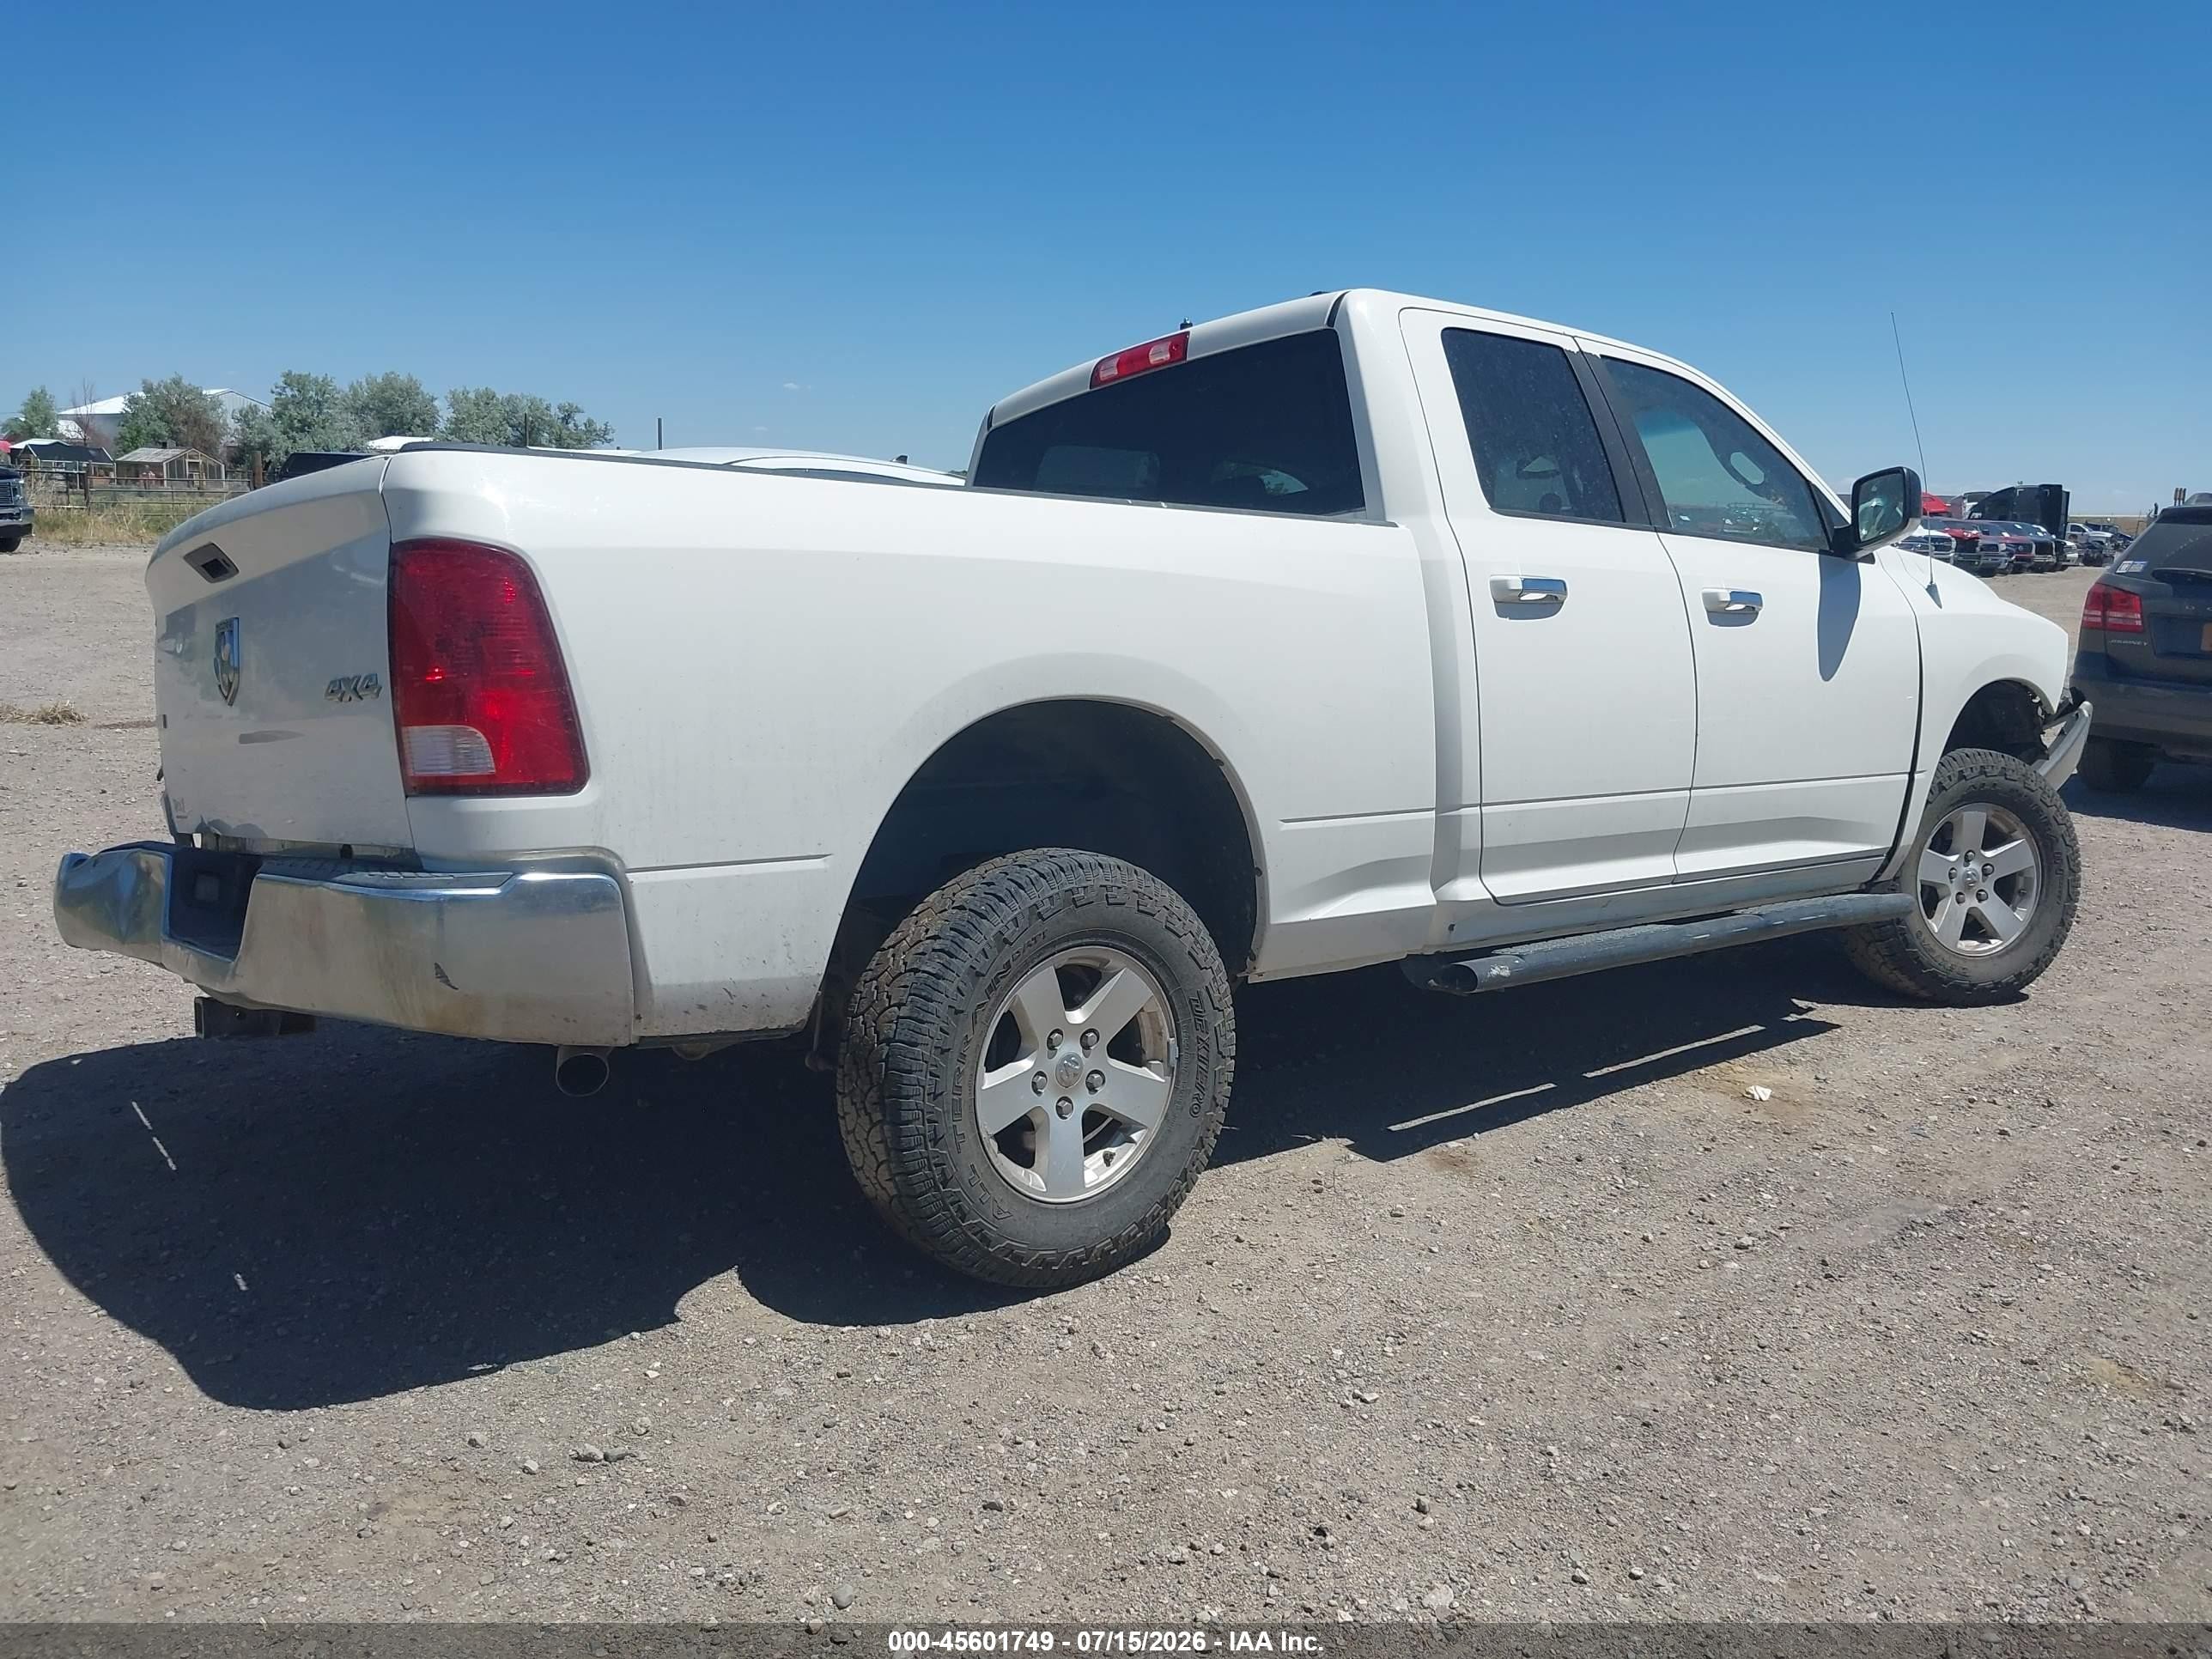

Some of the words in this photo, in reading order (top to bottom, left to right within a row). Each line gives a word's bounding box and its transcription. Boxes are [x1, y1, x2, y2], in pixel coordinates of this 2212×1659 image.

[951, 957, 1012, 1155] TERRAIN
[1188, 989, 1210, 1119] DEXTERO
[969, 1161, 1013, 1220] ALL
